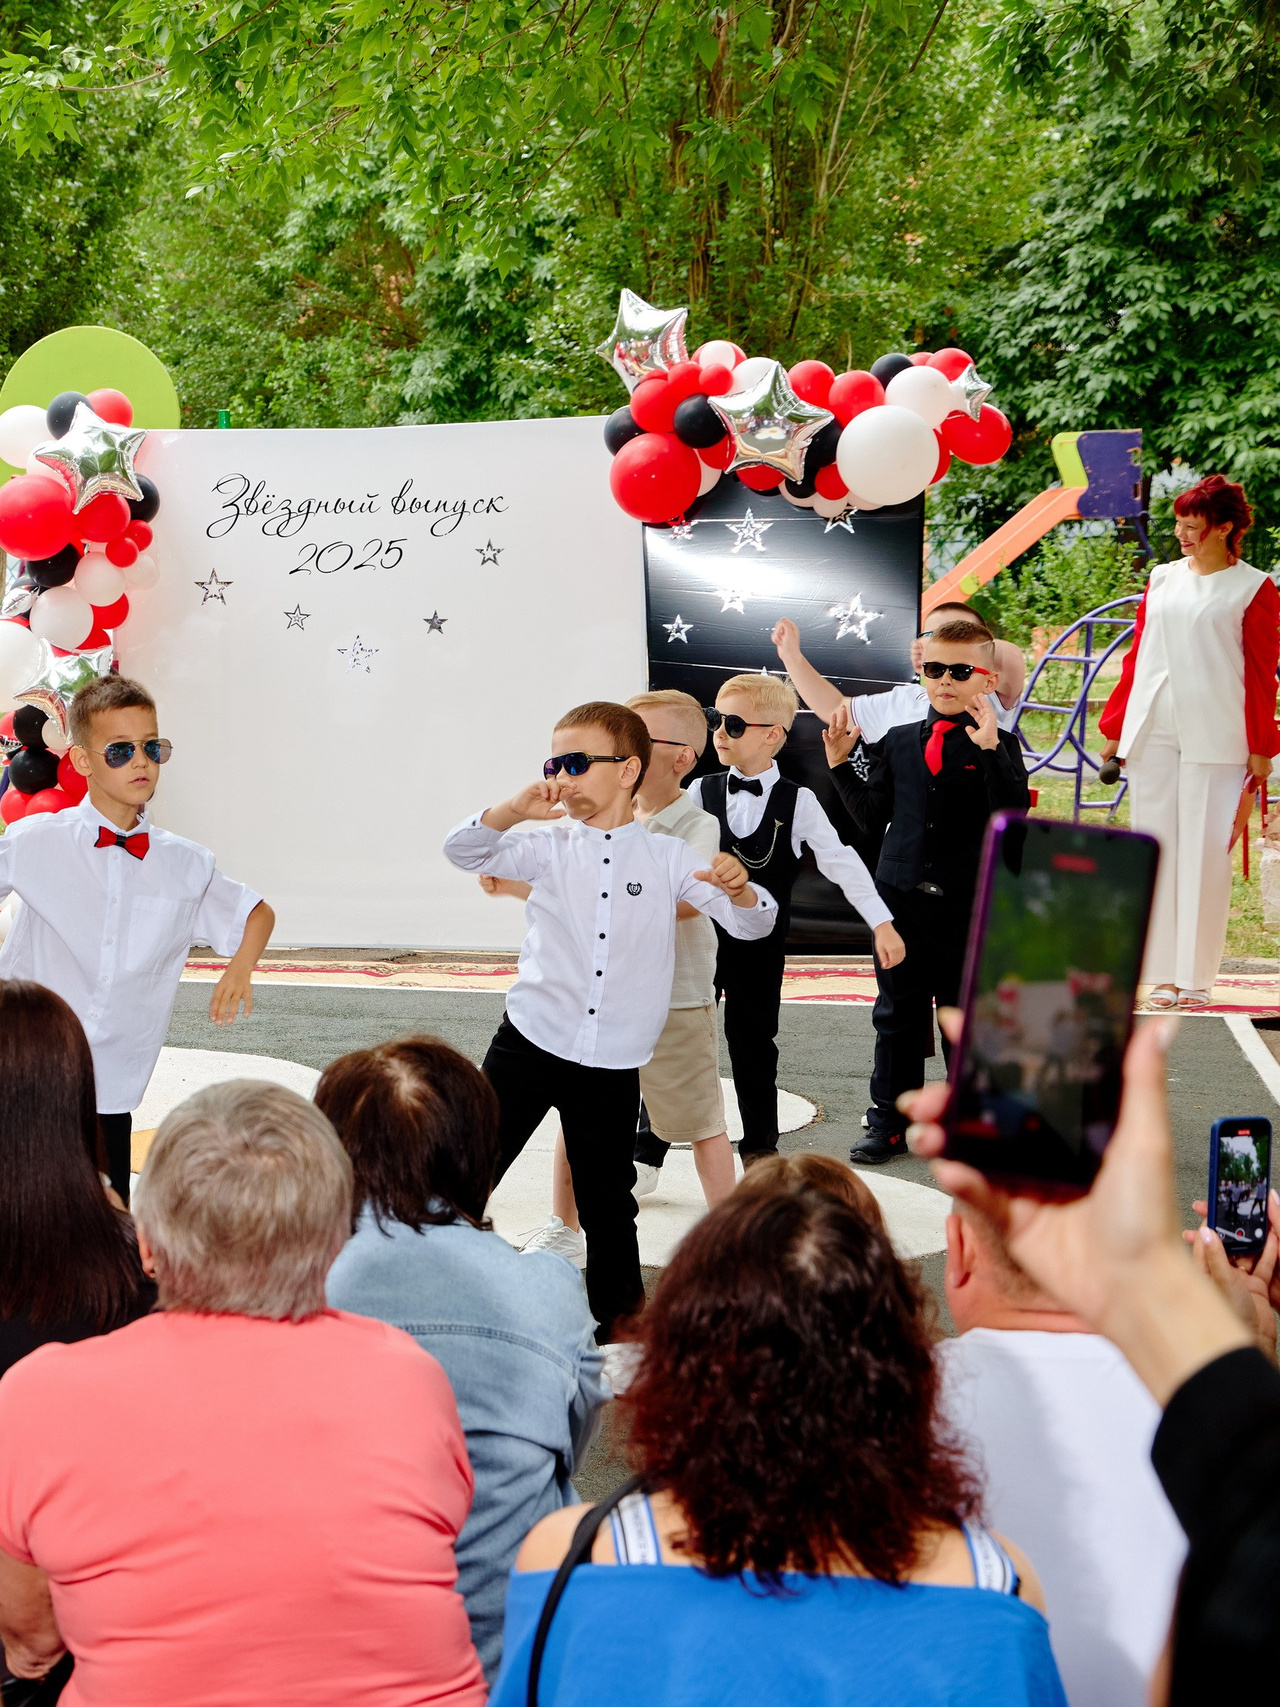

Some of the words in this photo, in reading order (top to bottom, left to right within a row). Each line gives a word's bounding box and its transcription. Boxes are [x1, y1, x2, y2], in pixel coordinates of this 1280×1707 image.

[205, 472, 382, 538] Звёздный
[390, 478, 510, 538] выпуск
[288, 538, 408, 576] 2025
